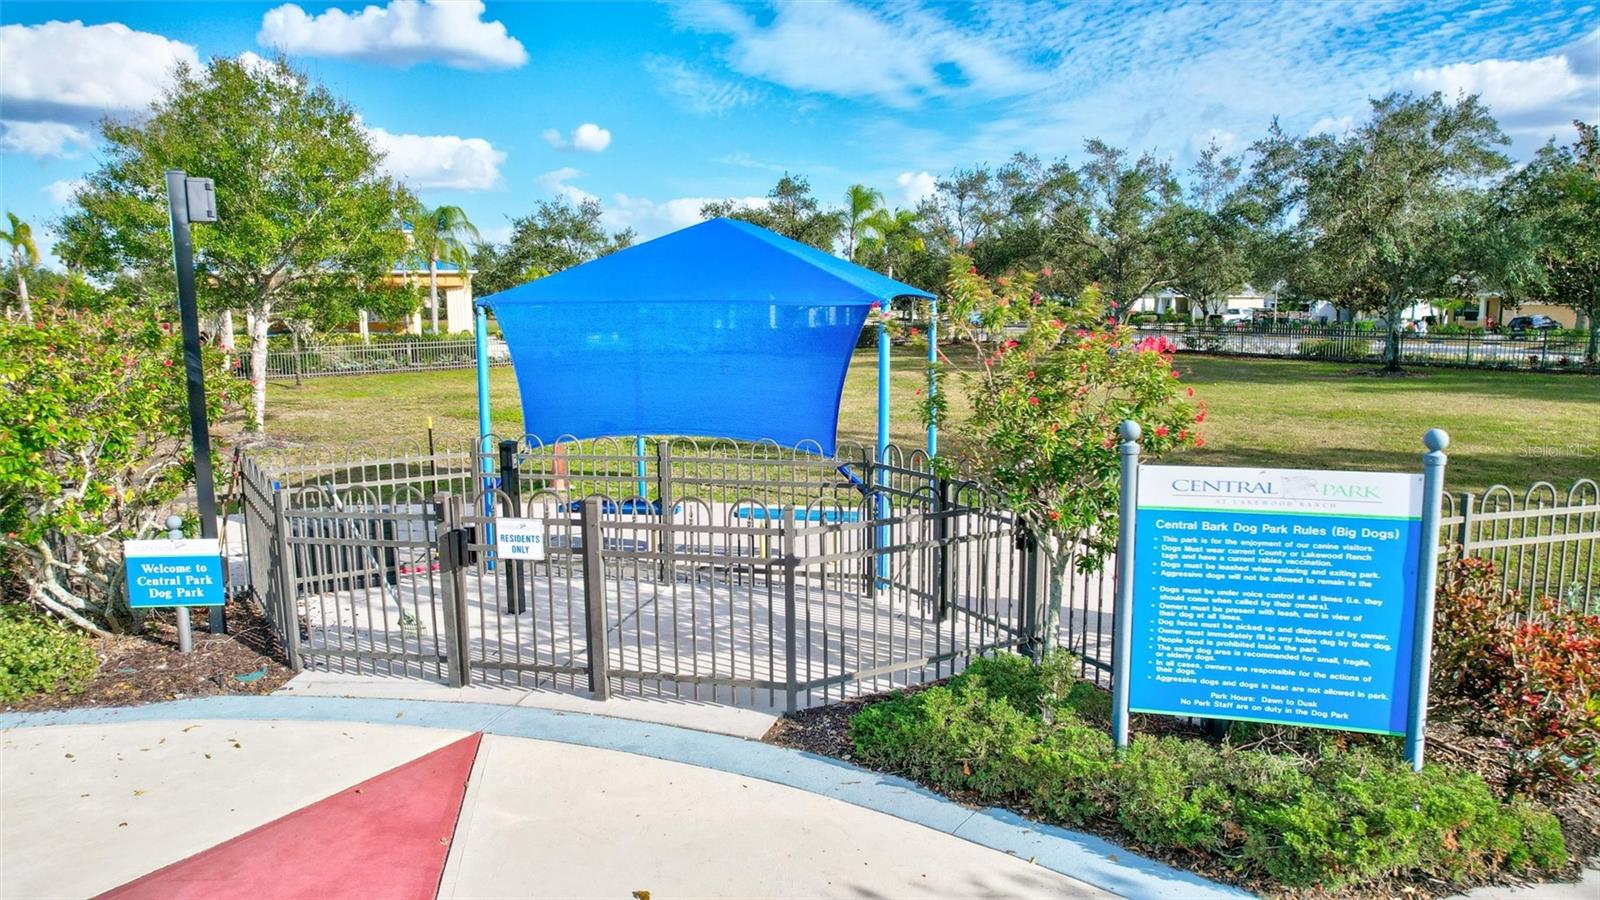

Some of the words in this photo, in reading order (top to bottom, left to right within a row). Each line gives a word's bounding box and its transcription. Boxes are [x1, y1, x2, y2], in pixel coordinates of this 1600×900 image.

[1172, 480, 1278, 494] CENTRAL
[1322, 483, 1382, 498] PARK
[1156, 520, 1197, 530] Central
[1202, 522, 1227, 532] Bark
[1233, 523, 1257, 534] Dog
[1262, 524, 1287, 534] Park
[1293, 526, 1326, 535] Rules
[1332, 527, 1356, 538] (Big
[1361, 528, 1400, 540] Dogs)
[500, 534, 540, 543] RESIDENTS
[512, 545, 529, 553] ONLY
[1241, 540, 1281, 548] enjoyment
[1343, 544, 1375, 552] visitors.
[1259, 549, 1287, 557] County
[1301, 551, 1343, 559] Lakewood
[141, 564, 191, 573] Welcome
[196, 564, 207, 572] to
[1161, 570, 1203, 578] Aggressive
[1275, 567, 1308, 575] entering
[1329, 570, 1357, 578] exiting
[137, 576, 180, 586] Central
[186, 575, 213, 585] Park
[149, 589, 172, 599] Dog
[177, 588, 204, 597] Park
[1160, 586, 1179, 594] Dogs
[1364, 598, 1383, 606] they
[1225, 607, 1255, 615] present
[1259, 608, 1274, 616] with
[1277, 610, 1300, 618] leash,
[1236, 623, 1262, 631] picked
[1296, 627, 1332, 636] disposed
[1157, 636, 1183, 644] People
[1216, 640, 1255, 649] prohibited
[1258, 642, 1280, 650] inside
[1207, 630, 1252, 640] immediately
[1320, 638, 1336, 646] dug
[1338, 640, 1348, 648] by
[1373, 643, 1392, 652] dog.
[1244, 651, 1299, 660] recommended
[1317, 656, 1340, 664] small,
[1343, 658, 1371, 667] fragile,
[1251, 667, 1296, 676] responsible
[1156, 675, 1197, 684] Aggressive
[1200, 678, 1219, 686] dogs
[1239, 681, 1258, 689] dogs
[1324, 688, 1354, 697] allowed
[1368, 692, 1389, 700] park.
[1230, 694, 1256, 702] Hours:
[1312, 710, 1328, 718] Dog
[1331, 711, 1349, 719] Park
